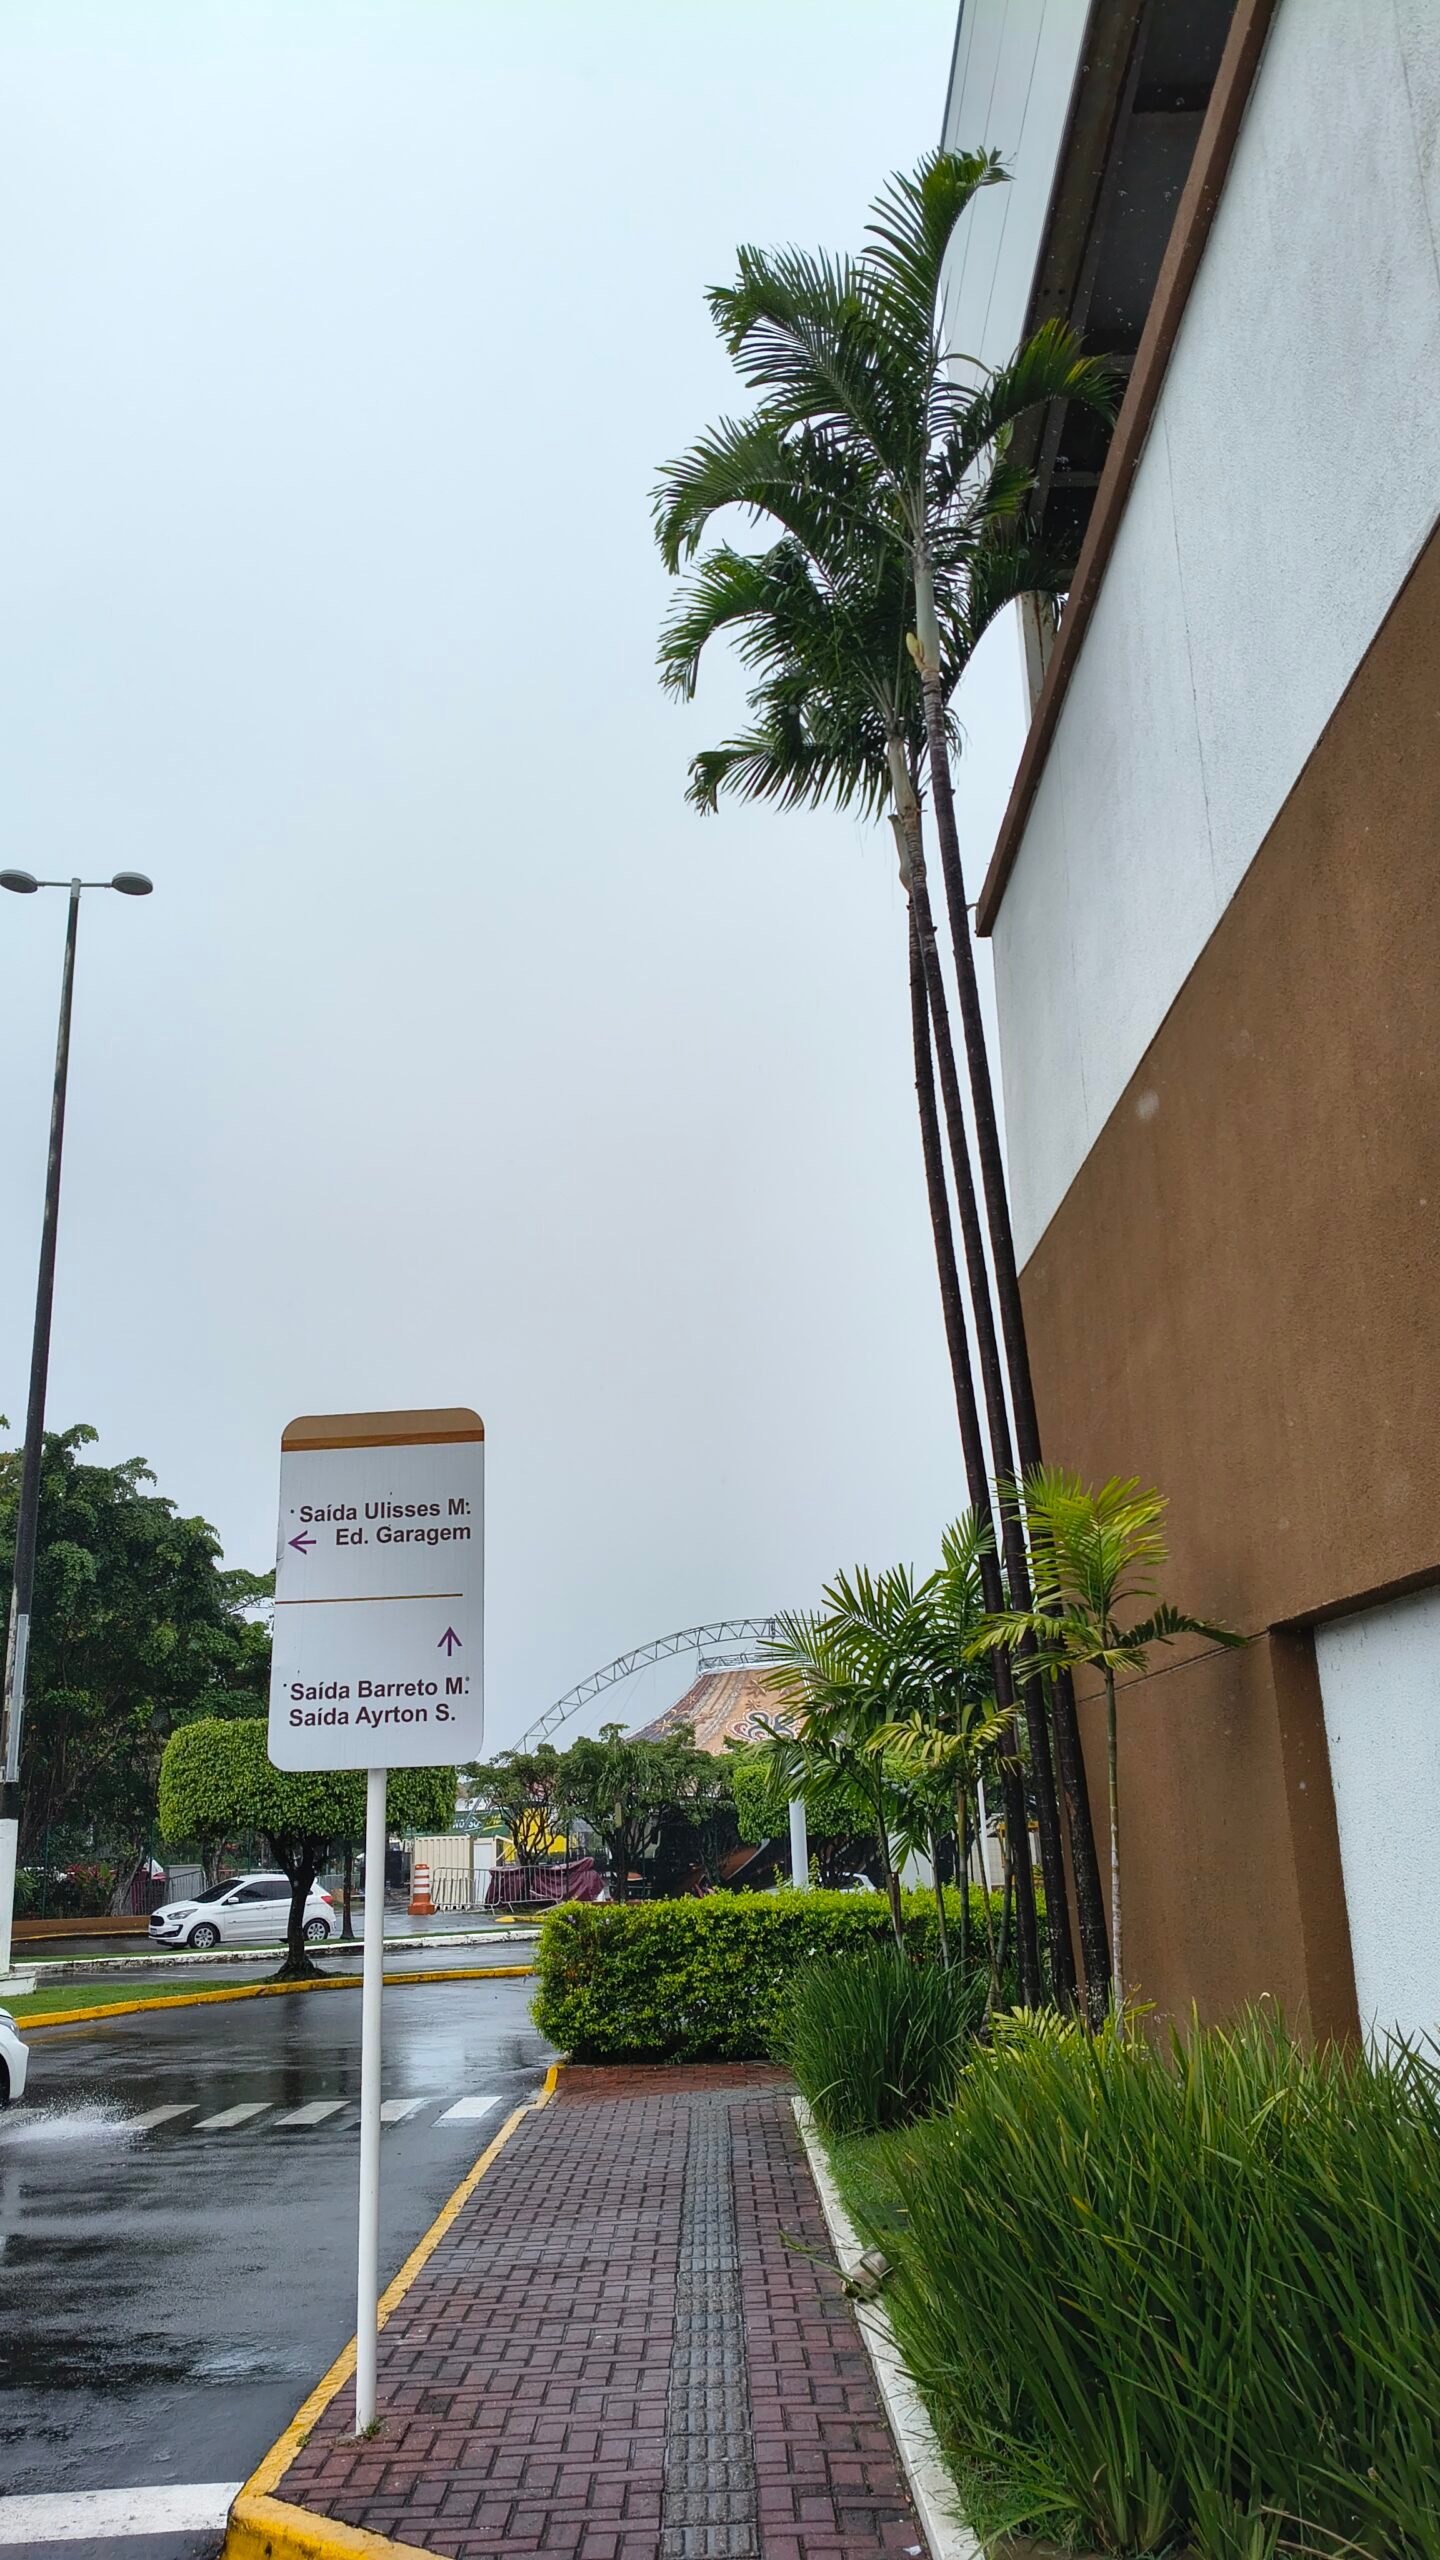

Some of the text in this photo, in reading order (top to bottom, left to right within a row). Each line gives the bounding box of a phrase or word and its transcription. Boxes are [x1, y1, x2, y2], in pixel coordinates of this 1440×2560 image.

[299, 1503, 358, 1523] Saída
[364, 1501, 441, 1520] Ulisses
[335, 1526, 471, 1546] Ed. Garagem
[290, 1681, 351, 1701] Saída
[357, 1678, 439, 1699] Barreto
[289, 1703, 456, 1729] Saída Ayrton S.
